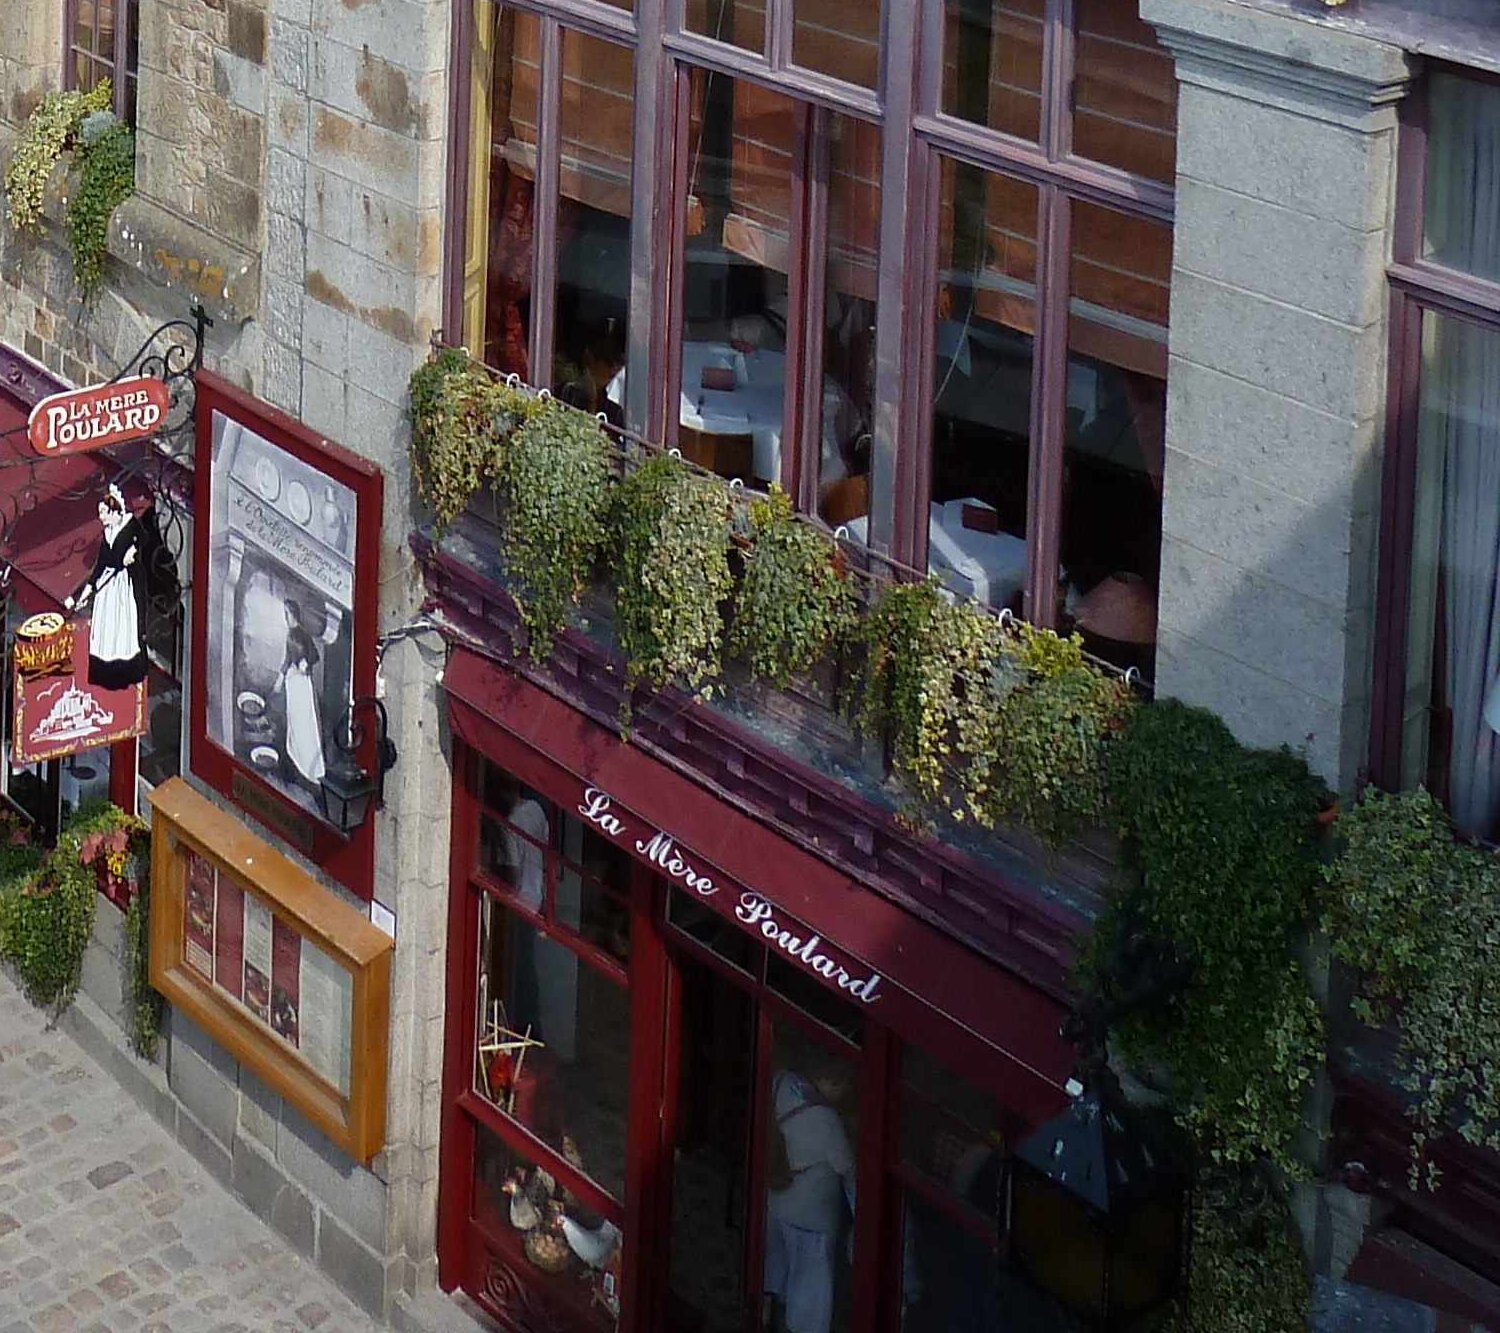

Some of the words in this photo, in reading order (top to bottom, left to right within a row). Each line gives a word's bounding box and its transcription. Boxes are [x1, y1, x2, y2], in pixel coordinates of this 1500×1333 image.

[46, 404, 160, 449] POULARD
[69, 402, 91, 420] LA
[96, 390, 149, 416] MERE
[578, 787, 626, 836] La
[636, 832, 720, 895] Mère
[735, 892, 882, 1003] Poulard
